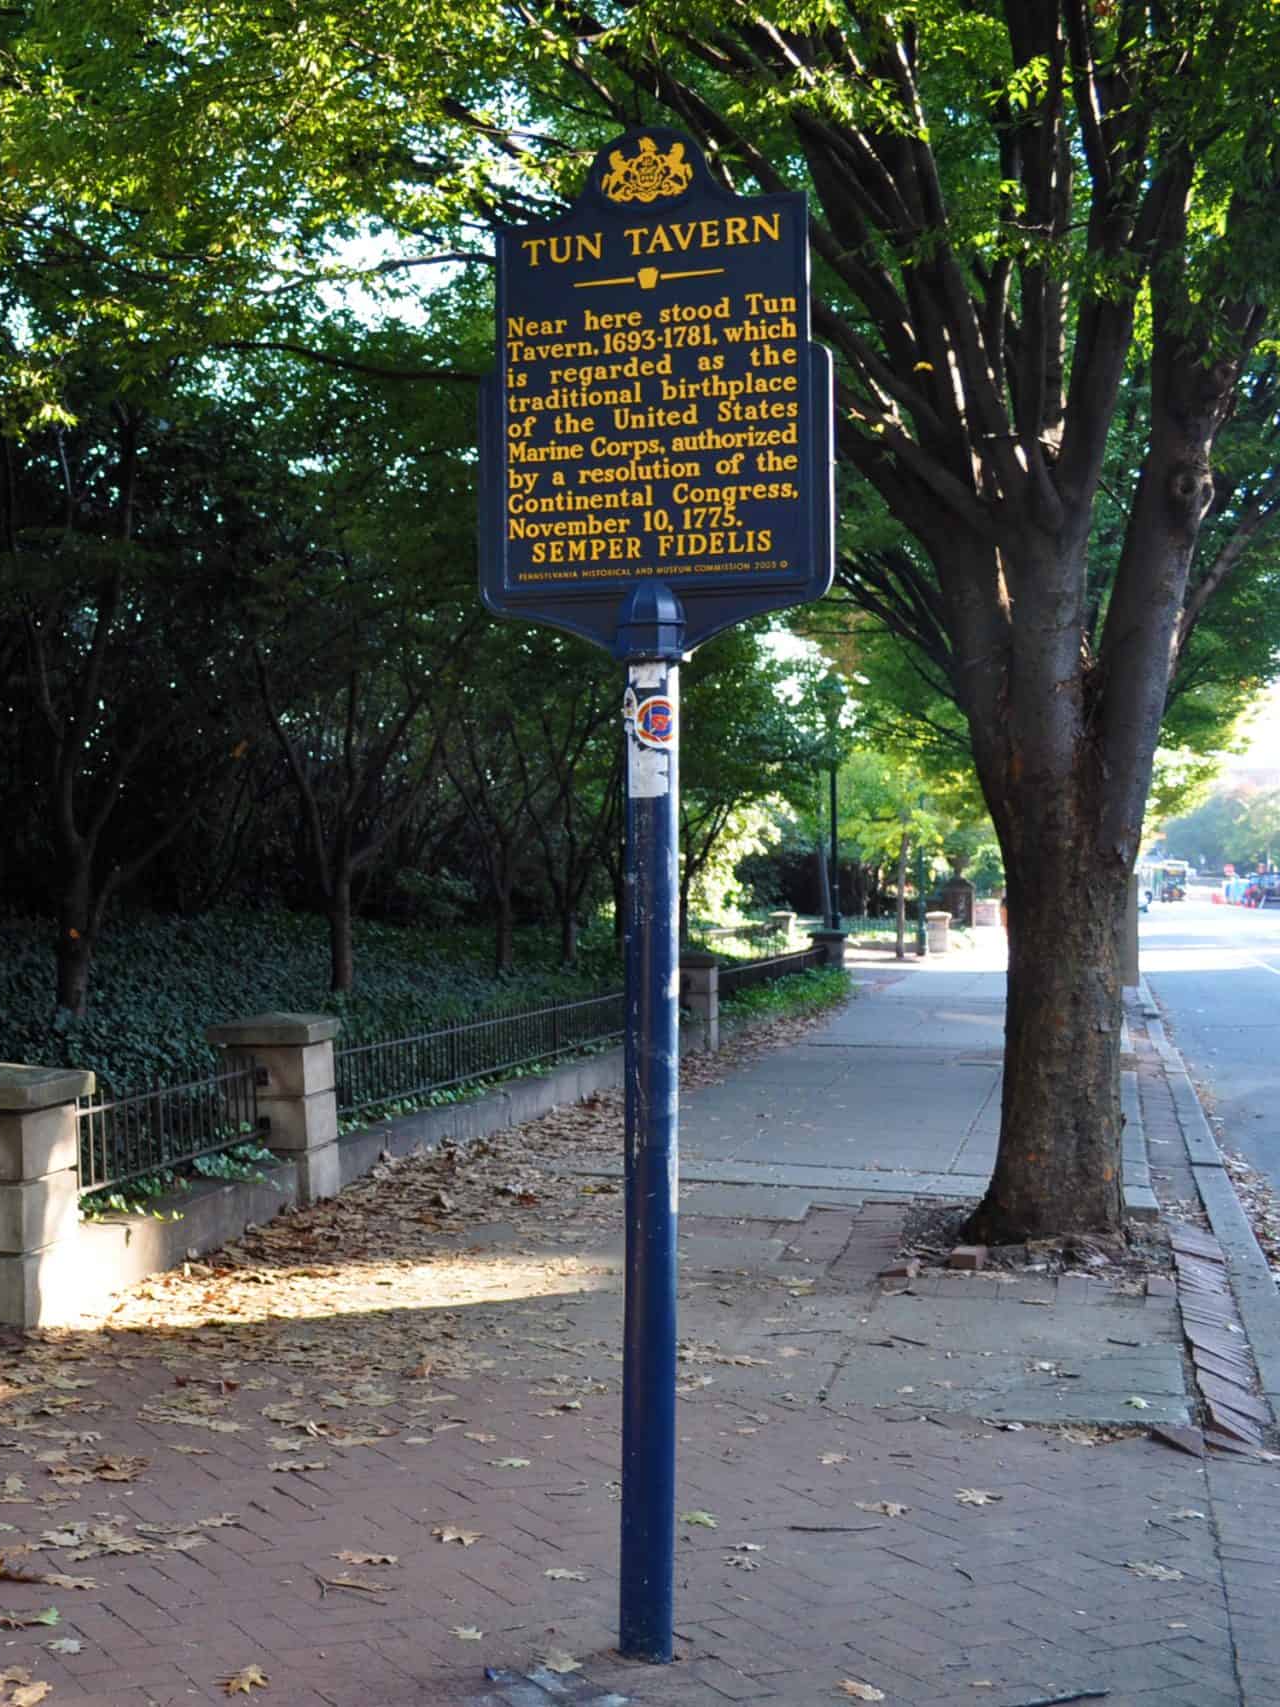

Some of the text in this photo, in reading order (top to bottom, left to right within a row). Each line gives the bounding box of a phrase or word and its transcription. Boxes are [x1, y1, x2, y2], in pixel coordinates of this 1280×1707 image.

[522, 213, 780, 266] TUN TAVERN
[507, 292, 797, 338] Near here stood Tun
[723, 316, 797, 343] which
[507, 345, 797, 389] is regarded as the
[508, 372, 798, 414] traditional birthplace
[507, 400, 798, 438] of the United States
[508, 422, 798, 464] Marine Corps, authorized
[508, 449, 798, 495] by a resolution of the
[507, 482, 799, 515] Continental Congress,
[508, 513, 631, 540] November
[683, 506, 743, 530] 1775.
[531, 529, 772, 564] SEMPER FIDELIS
[582, 568, 631, 577] HISTORICAL
[635, 567, 653, 576] AND
